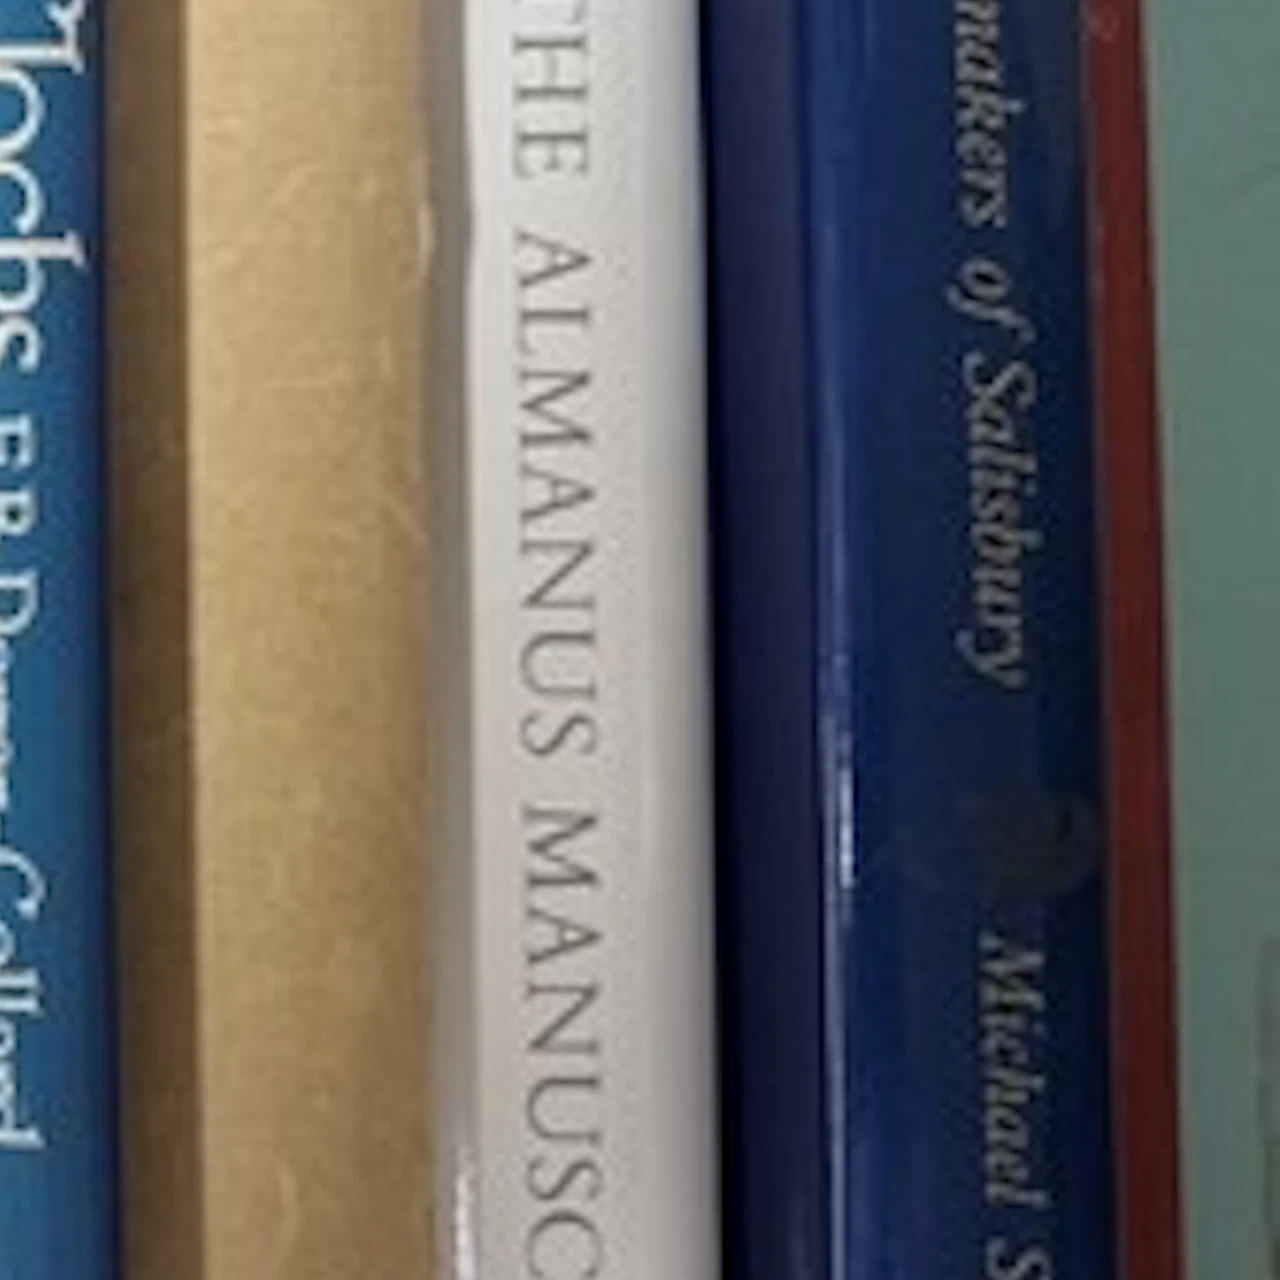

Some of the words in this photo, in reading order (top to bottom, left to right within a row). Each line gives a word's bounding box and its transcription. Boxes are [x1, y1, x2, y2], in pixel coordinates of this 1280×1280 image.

[947, 259, 1036, 342] of
[514, 225, 598, 762] ALMANUS
[956, 350, 1042, 690] Salisbury
[977, 928, 1049, 1212] Michael
